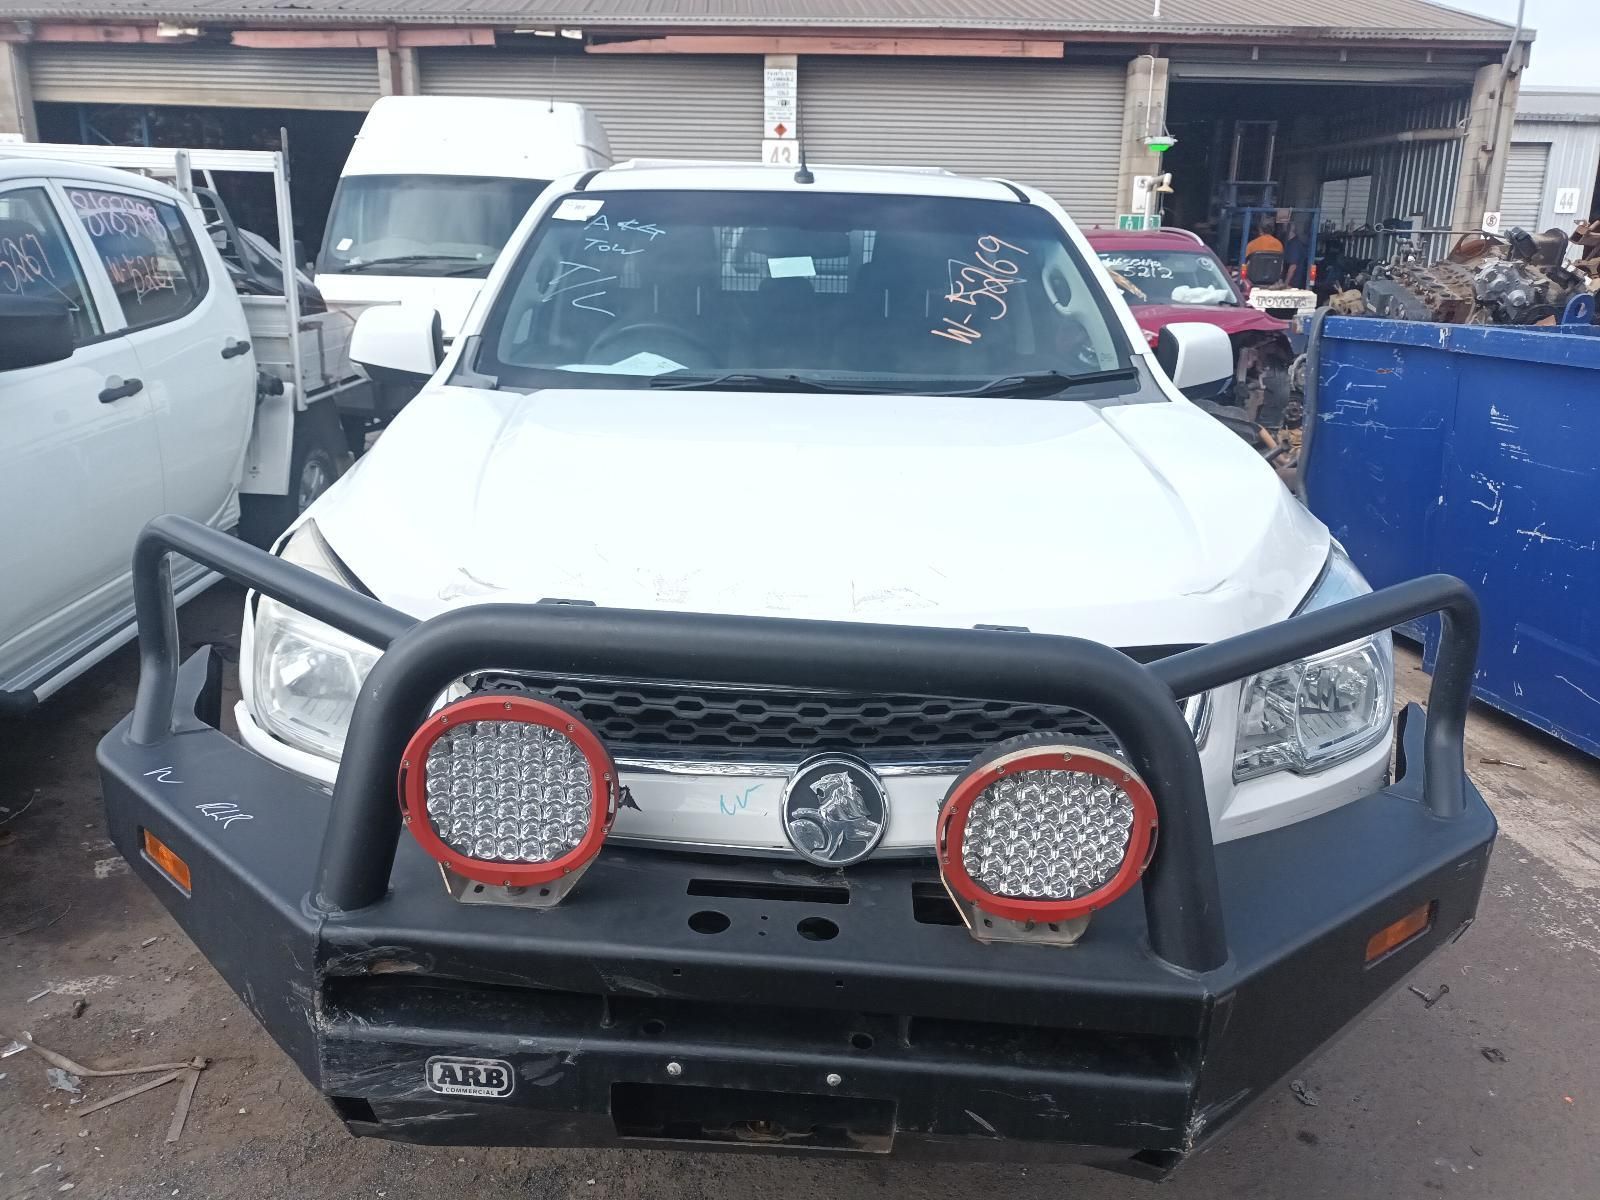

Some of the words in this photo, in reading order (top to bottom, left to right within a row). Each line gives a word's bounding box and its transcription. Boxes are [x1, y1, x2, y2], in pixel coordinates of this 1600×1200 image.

[1559, 192, 1575, 210] 44
[1256, 295, 1307, 307] TOYOTA
[437, 1064, 506, 1089] ARB
[445, 1087, 495, 1096] COMMERCIAL
